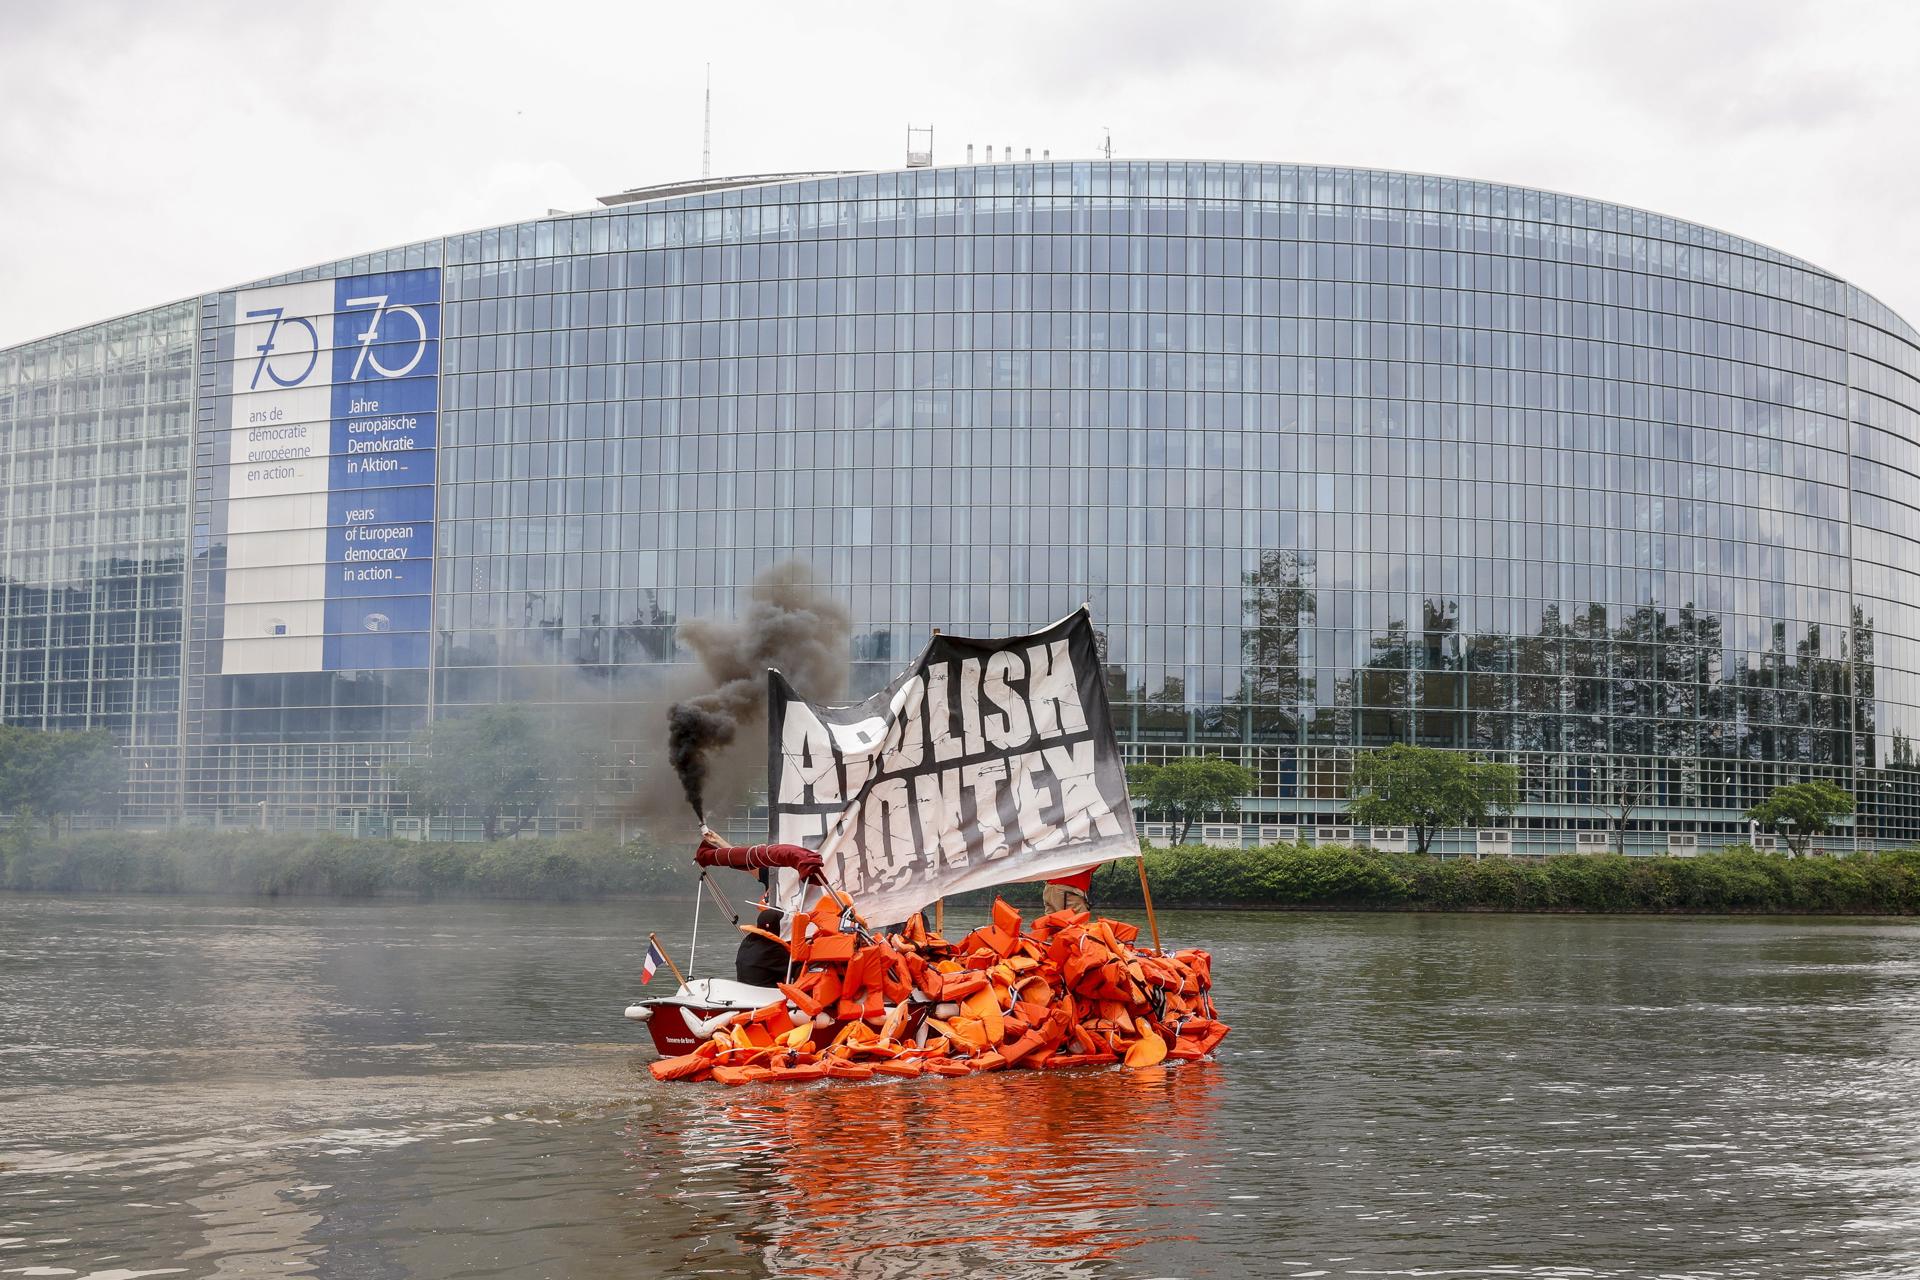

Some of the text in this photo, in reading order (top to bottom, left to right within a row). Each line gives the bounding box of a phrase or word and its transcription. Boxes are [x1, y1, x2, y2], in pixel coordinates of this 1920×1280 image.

[346, 295, 427, 380] 70
[246, 307, 319, 390] 70
[249, 406, 283, 423] ans de
[348, 398, 379, 414] Jahre
[248, 424, 307, 442] démocratie
[348, 416, 417, 435] europäische
[348, 435, 414, 453] Demokratie
[248, 444, 311, 462] européenne
[247, 465, 295, 481] en action
[347, 457, 398, 474] in Aktion
[345, 508, 375, 525] years
[345, 526, 413, 543] of European
[345, 547, 408, 562] democracy
[344, 566, 392, 582] in action
[778, 638, 1089, 804] ABOLISH
[777, 740, 1124, 908] FRONTEX
